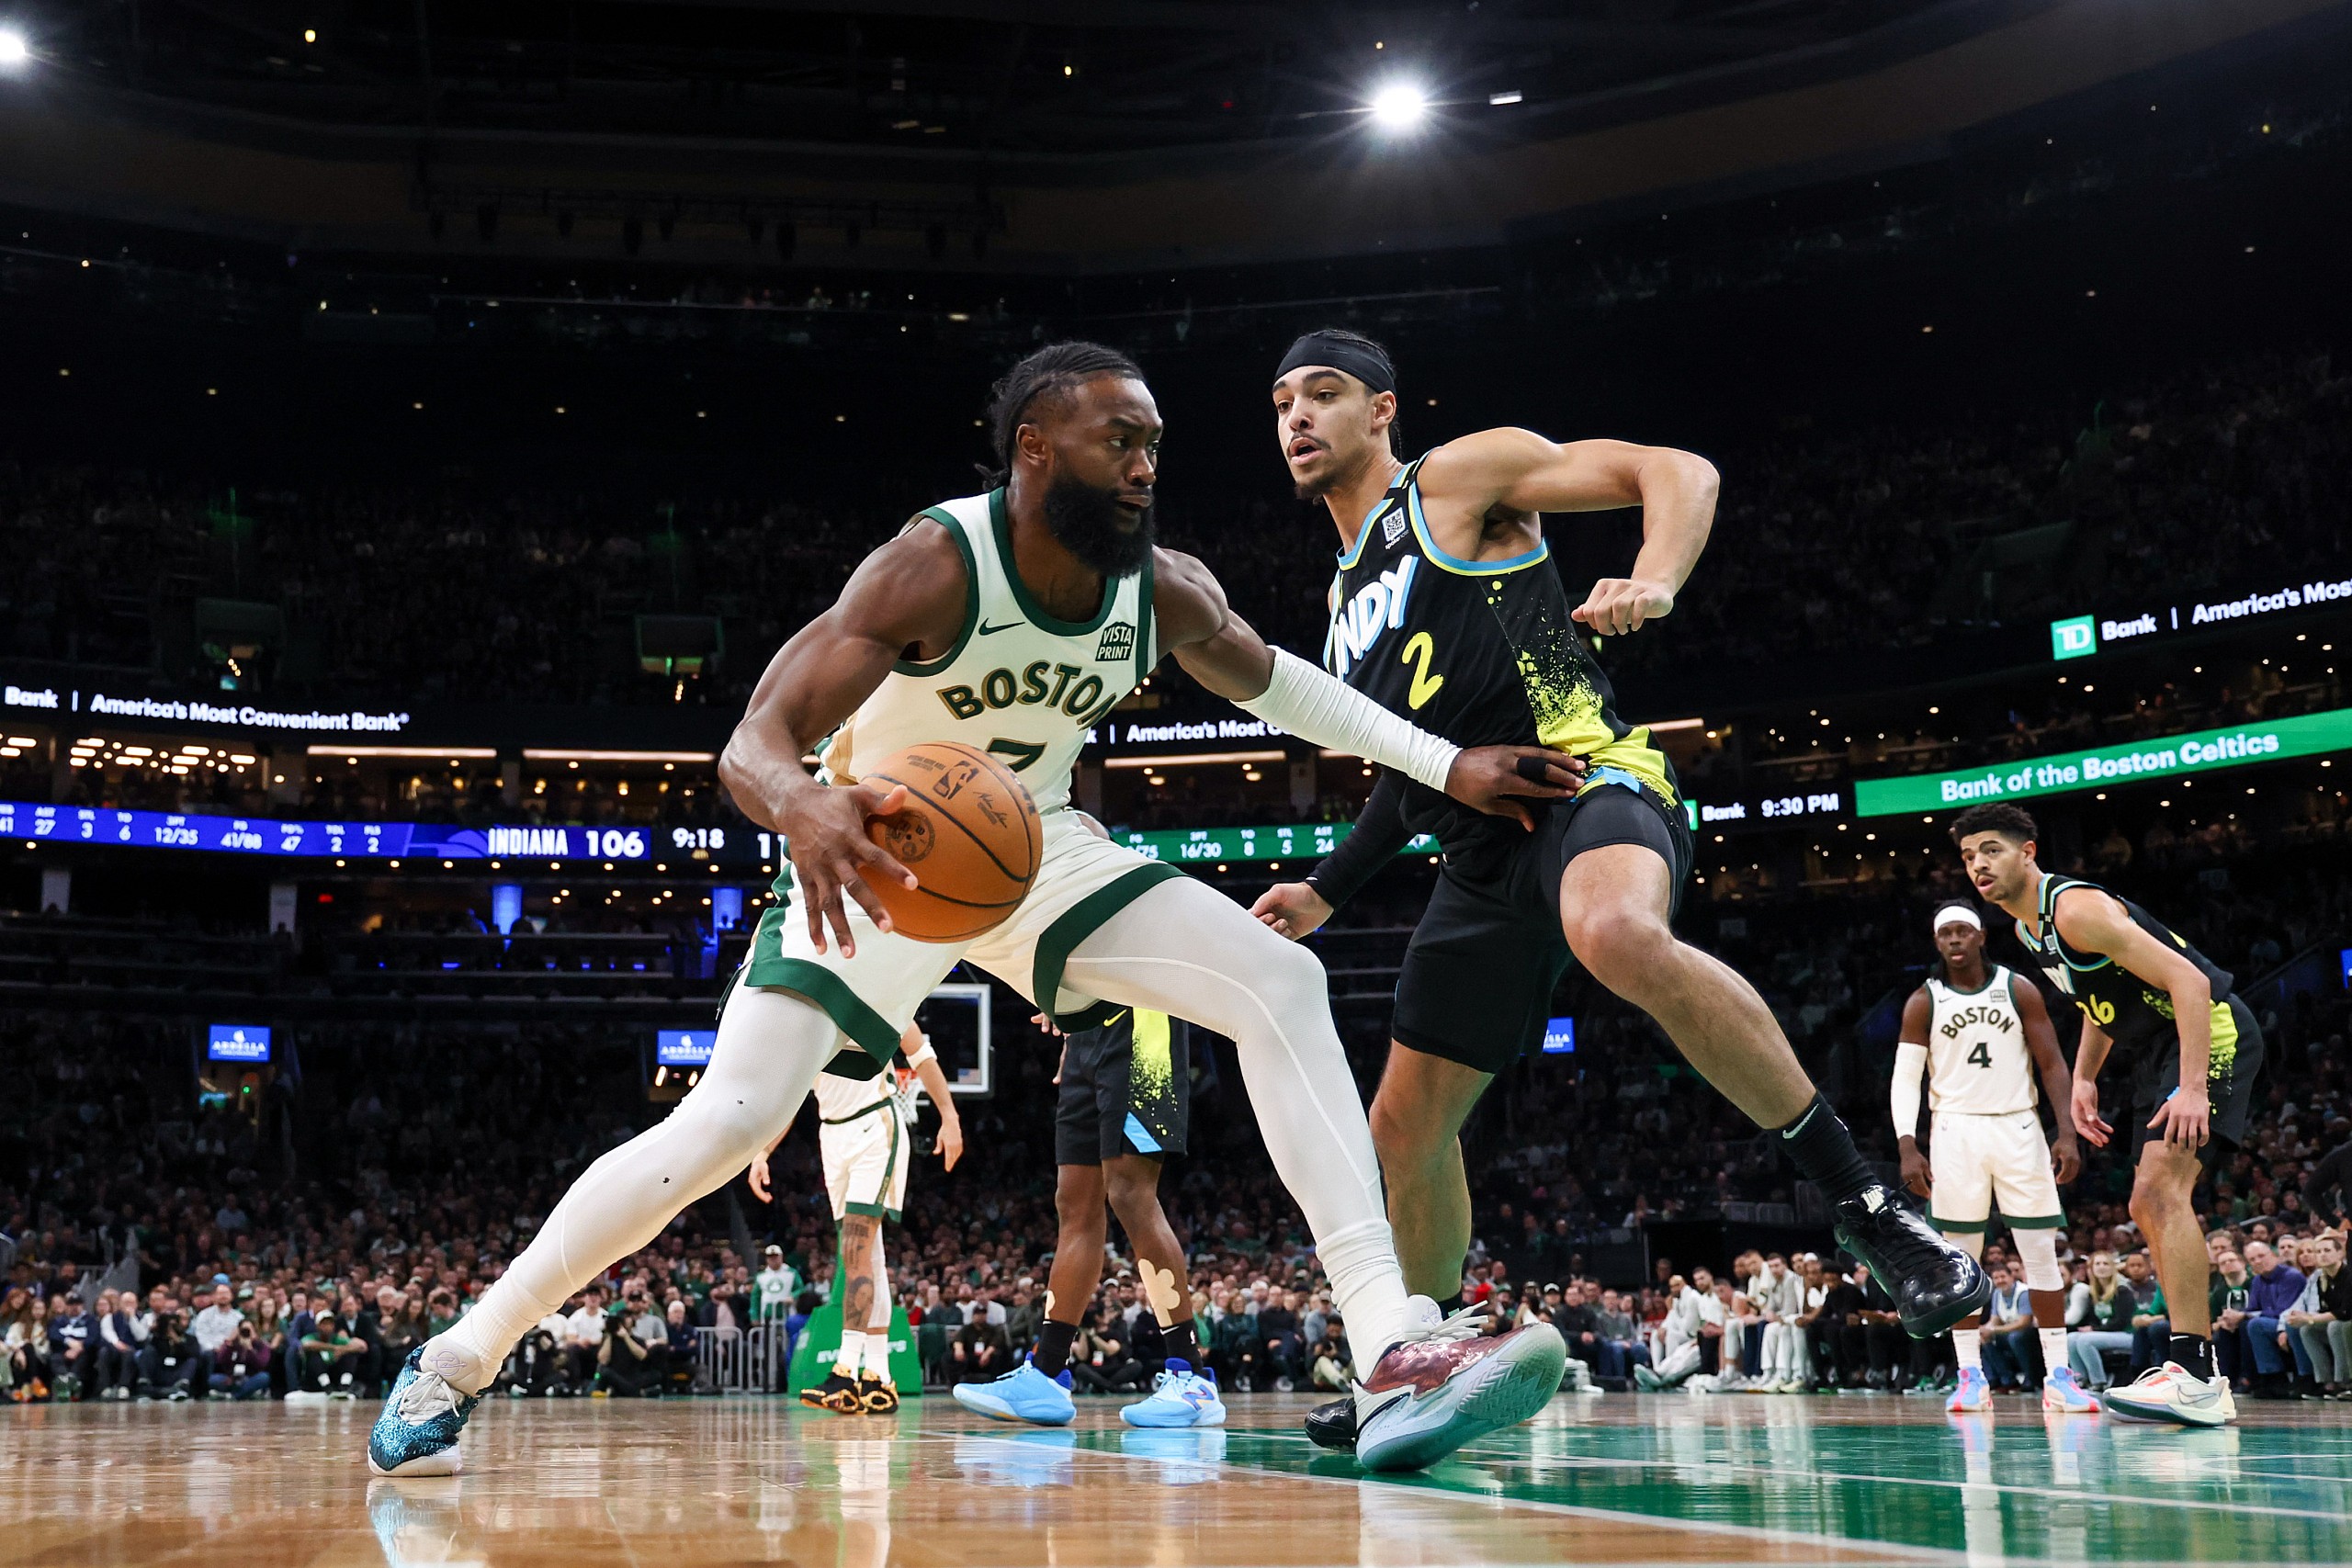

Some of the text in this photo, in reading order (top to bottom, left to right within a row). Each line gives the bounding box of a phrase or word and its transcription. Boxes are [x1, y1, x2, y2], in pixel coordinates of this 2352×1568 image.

[2101, 614, 2157, 641] Bank
[2192, 588, 2301, 625] America's
[1102, 626, 1132, 644] VISTA
[1097, 646, 1131, 660] PRINT
[1402, 632, 1443, 710] 2
[5, 686, 58, 708] Bank
[90, 694, 187, 719] America's
[189, 702, 238, 724] Most
[239, 706, 349, 730] Convenient
[1126, 721, 1216, 742] America's
[1218, 720, 1266, 739] Most
[987, 737, 1047, 773] 7
[1940, 733, 2280, 802] Bank of the Boston Celtics
[1702, 802, 1746, 822] Bank
[1761, 796, 1804, 818] 9:30
[1807, 793, 1838, 813] PM
[34, 818, 56, 835] 27
[81, 822, 93, 839] 3
[119, 825, 131, 840] 6
[154, 827, 198, 845] 12/35
[280, 835, 301, 852] 47
[331, 837, 343, 852] 2
[368, 837, 379, 853] 2
[488, 828, 569, 855] INDIANA
[585, 829, 644, 858] 106
[672, 828, 725, 850] 9:18
[1181, 842, 1222, 859] 16/30
[1243, 840, 1255, 857] 8
[1281, 839, 1293, 855] 5
[1315, 838, 1335, 853] 24
[1940, 1007, 2015, 1040] BOSTON
[2075, 993, 2115, 1026] 26
[1967, 1042, 1993, 1069] 4
